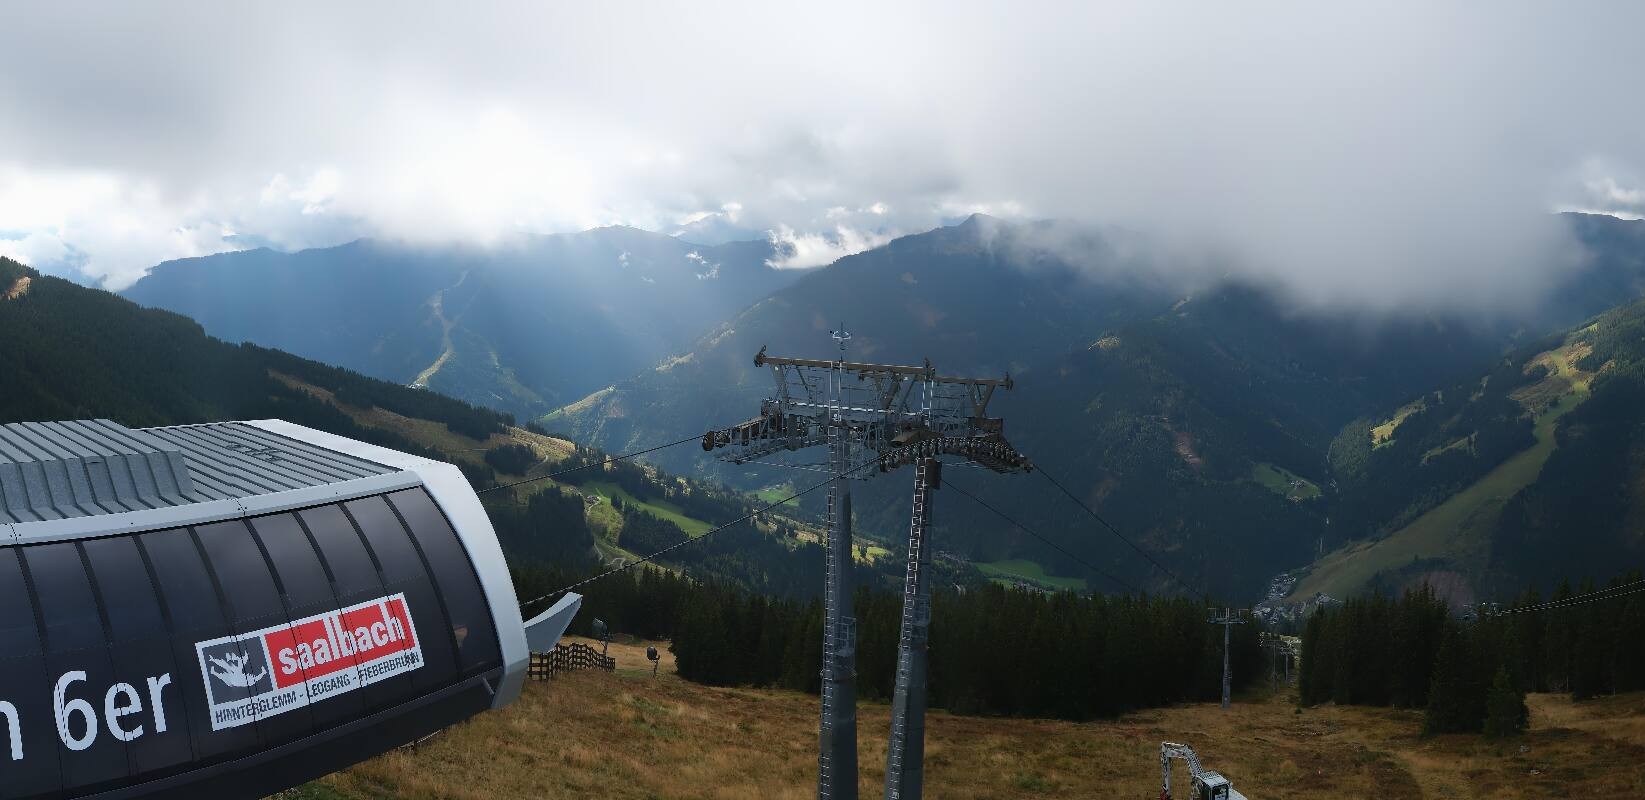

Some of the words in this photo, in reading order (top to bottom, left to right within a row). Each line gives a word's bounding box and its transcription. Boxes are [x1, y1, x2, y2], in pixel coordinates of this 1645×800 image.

[279, 603, 406, 675] saalbach
[53, 670, 172, 751] 6er
[307, 673, 351, 698] LEOGANG
